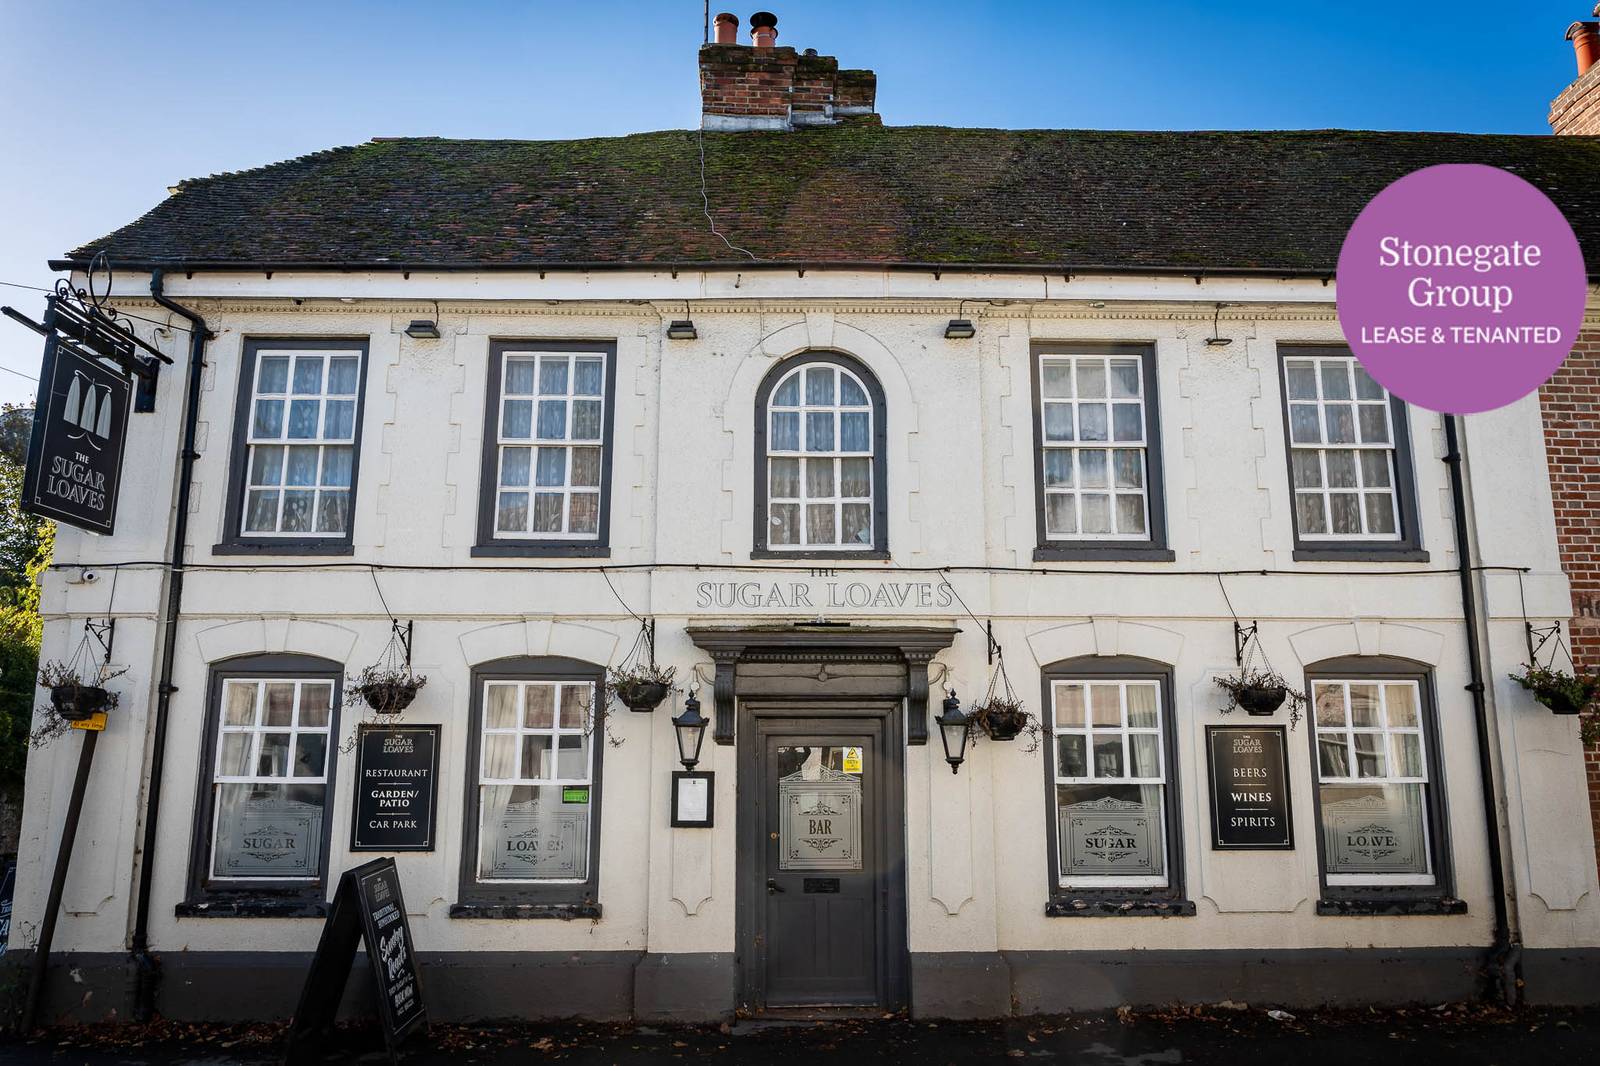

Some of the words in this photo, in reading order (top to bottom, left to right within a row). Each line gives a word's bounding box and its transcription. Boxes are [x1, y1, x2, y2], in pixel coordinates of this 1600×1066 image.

[75, 451, 89, 464] THE
[52, 456, 105, 492] SUGAR
[47, 474, 105, 511] LOAVES
[696, 582, 814, 608] SUGAR
[827, 582, 953, 608] LOAVES
[384, 738, 414, 746] SUGAR
[1233, 739, 1262, 747] SUGAR
[383, 745, 414, 753] LOAVES
[365, 769, 428, 778] RESTAURANT
[1233, 768, 1267, 778] BEERS
[371, 790, 419, 799] GARDEN/
[1231, 792, 1272, 802] WINES
[379, 799, 410, 808] PATIO
[369, 820, 389, 829] CAR
[393, 820, 417, 829] PARK
[809, 819, 832, 835] BAR
[1231, 817, 1276, 827] SPIRITS
[243, 838, 296, 849] SUGAR
[1085, 838, 1137, 849] SUGAR
[1347, 836, 1398, 847] LOAVE
